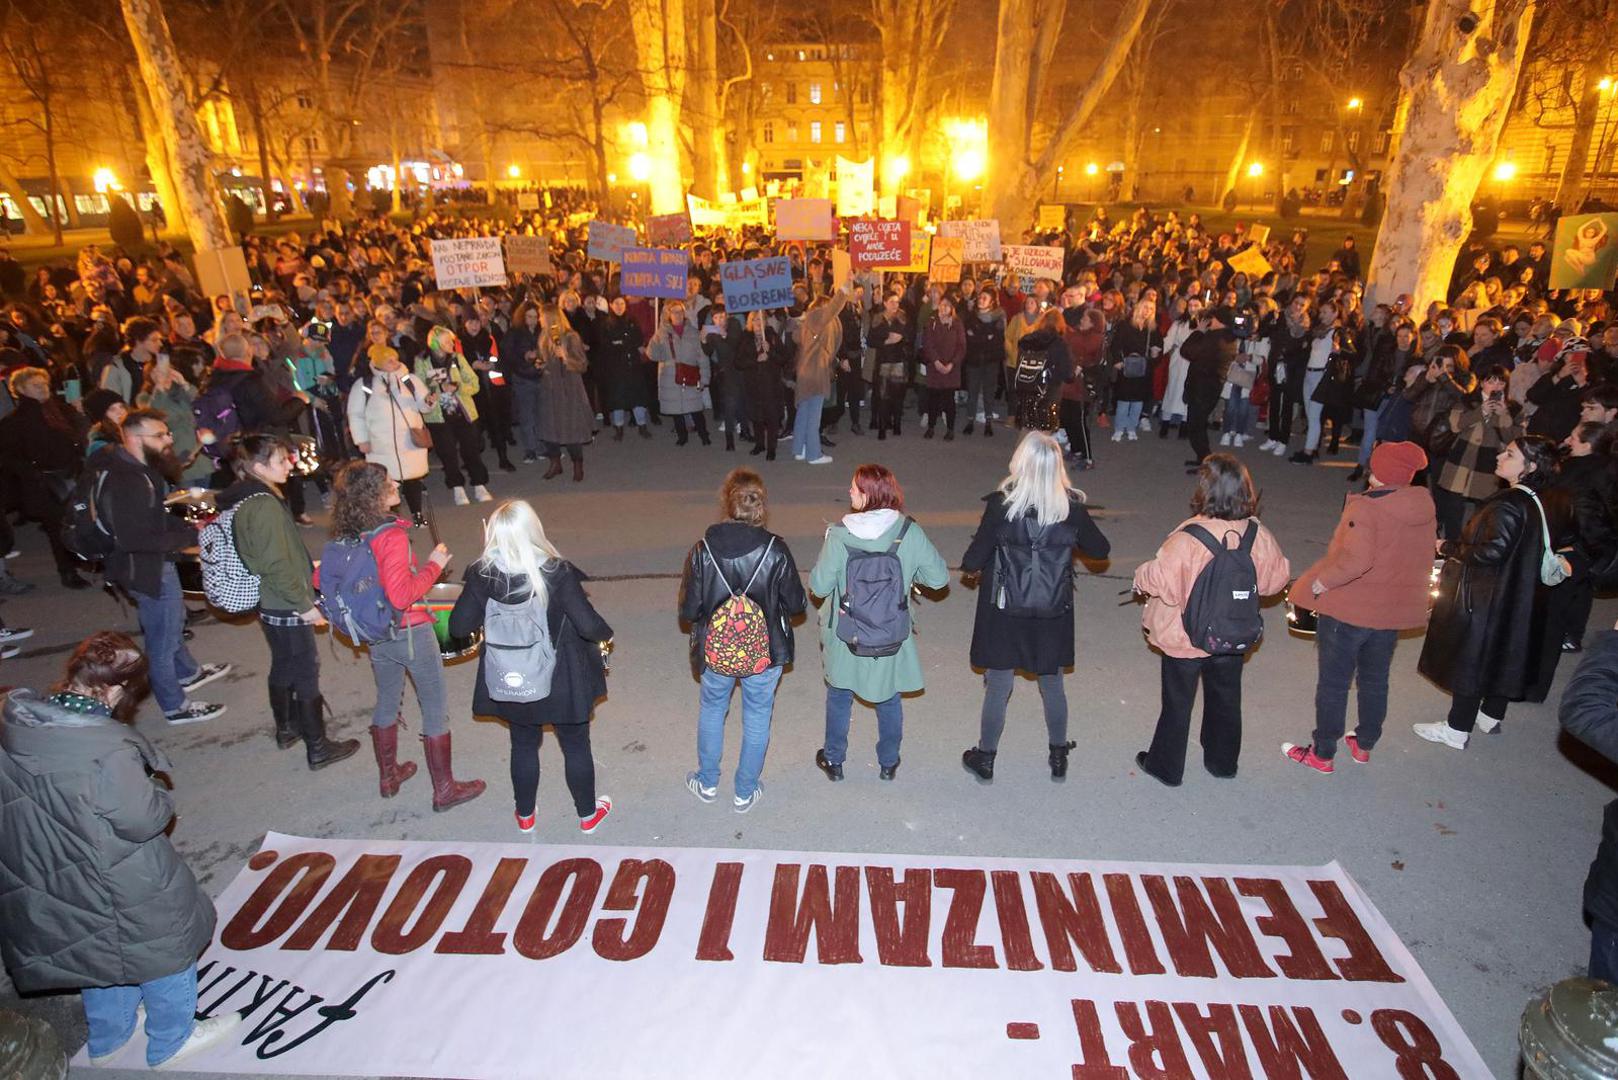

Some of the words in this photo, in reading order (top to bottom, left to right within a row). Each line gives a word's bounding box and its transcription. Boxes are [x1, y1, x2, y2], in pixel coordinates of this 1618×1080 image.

[852, 222, 874, 234] NEKA
[452, 239, 497, 251] NEPRAVDA
[440, 253, 474, 265] POSTANE
[858, 248, 902, 262] PODUZEĆE
[1009, 247, 1021, 258] JE
[1024, 247, 1053, 257] UZROK
[446, 261, 489, 275] OTPOR
[724, 261, 787, 281] GLASNE
[753, 279, 758, 289] I
[727, 287, 797, 310] BORBENE
[220, 849, 677, 961] GOTOVO.
[695, 862, 745, 962] I
[762, 862, 1406, 983] FEMINIZAM
[1071, 998, 1350, 1080] MART
